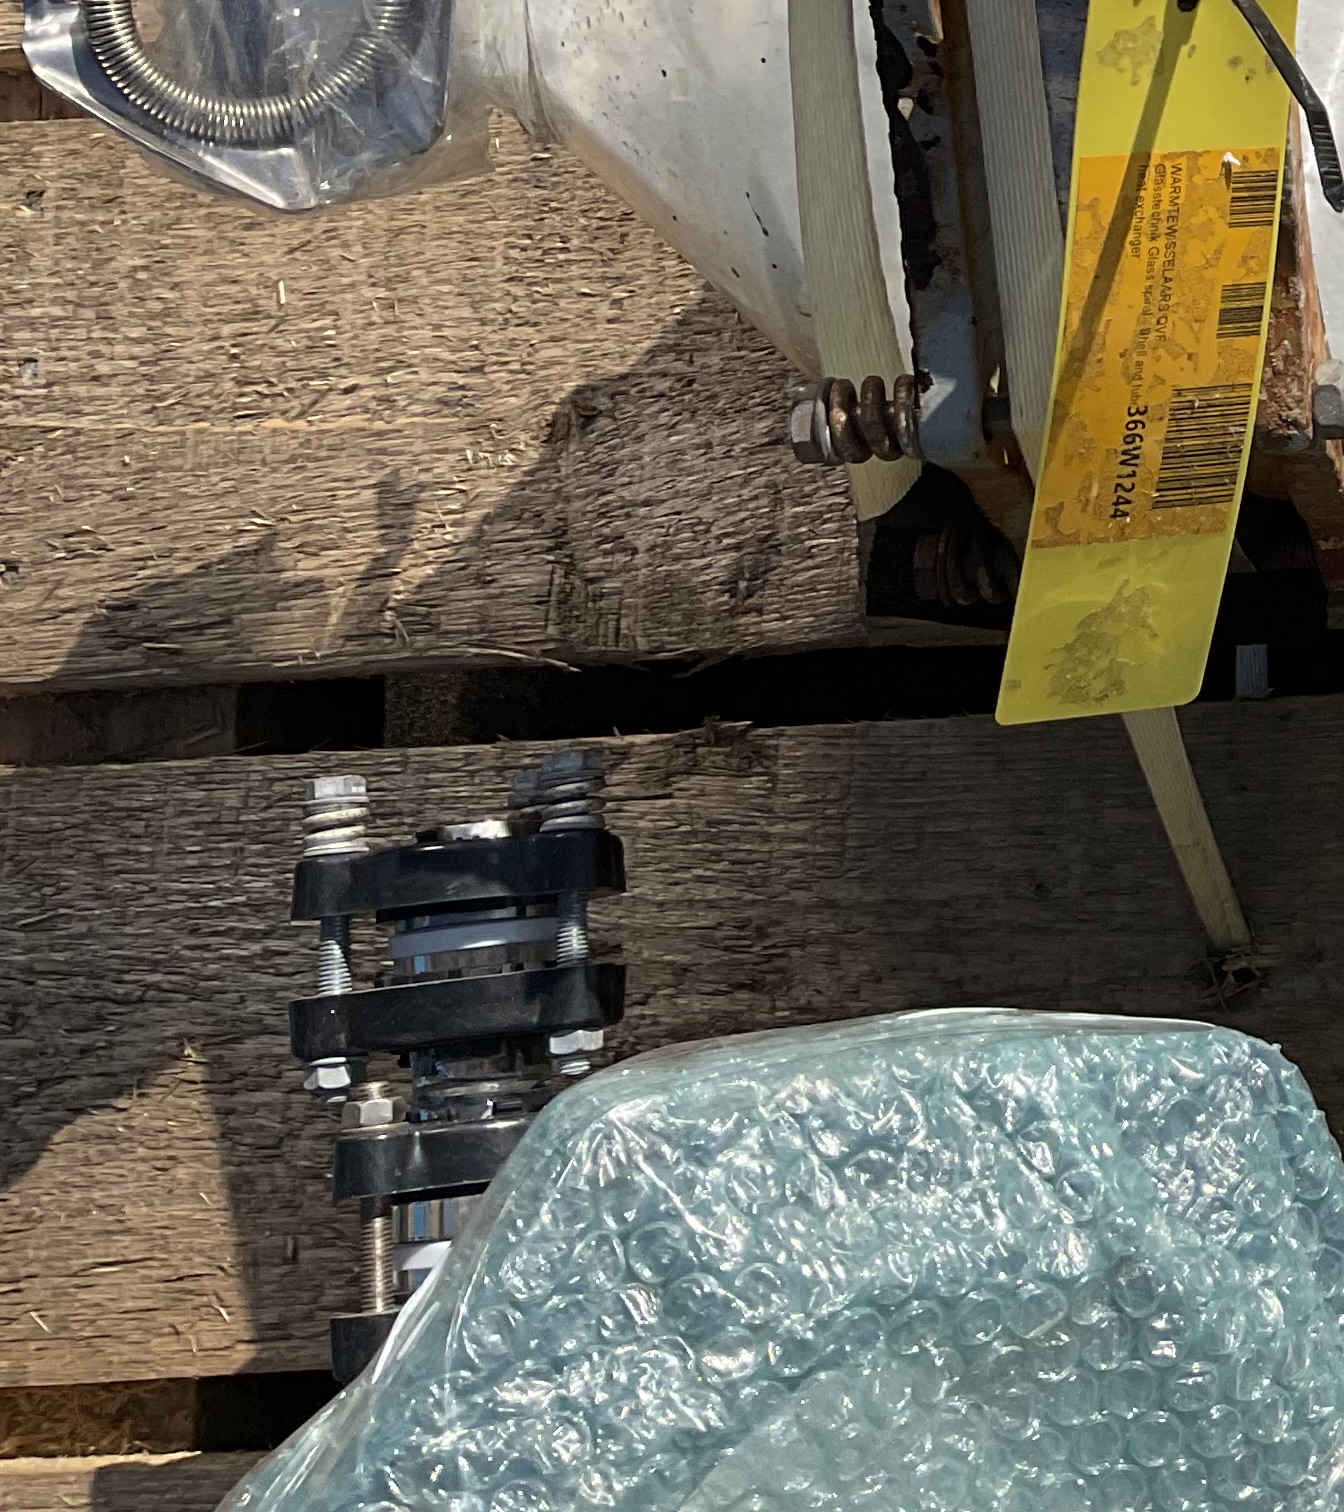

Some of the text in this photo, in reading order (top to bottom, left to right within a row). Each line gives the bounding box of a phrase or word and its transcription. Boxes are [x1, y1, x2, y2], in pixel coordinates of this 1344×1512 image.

[1129, 165, 1149, 258] heat exchanger
[1149, 164, 1165, 241] Glasstechnik
[1145, 247, 1160, 280] Glass
[1155, 163, 1183, 342] WARMTEWISSELAARS QVF
[1132, 361, 1144, 380] and
[1110, 406, 1148, 519] 366W1244
